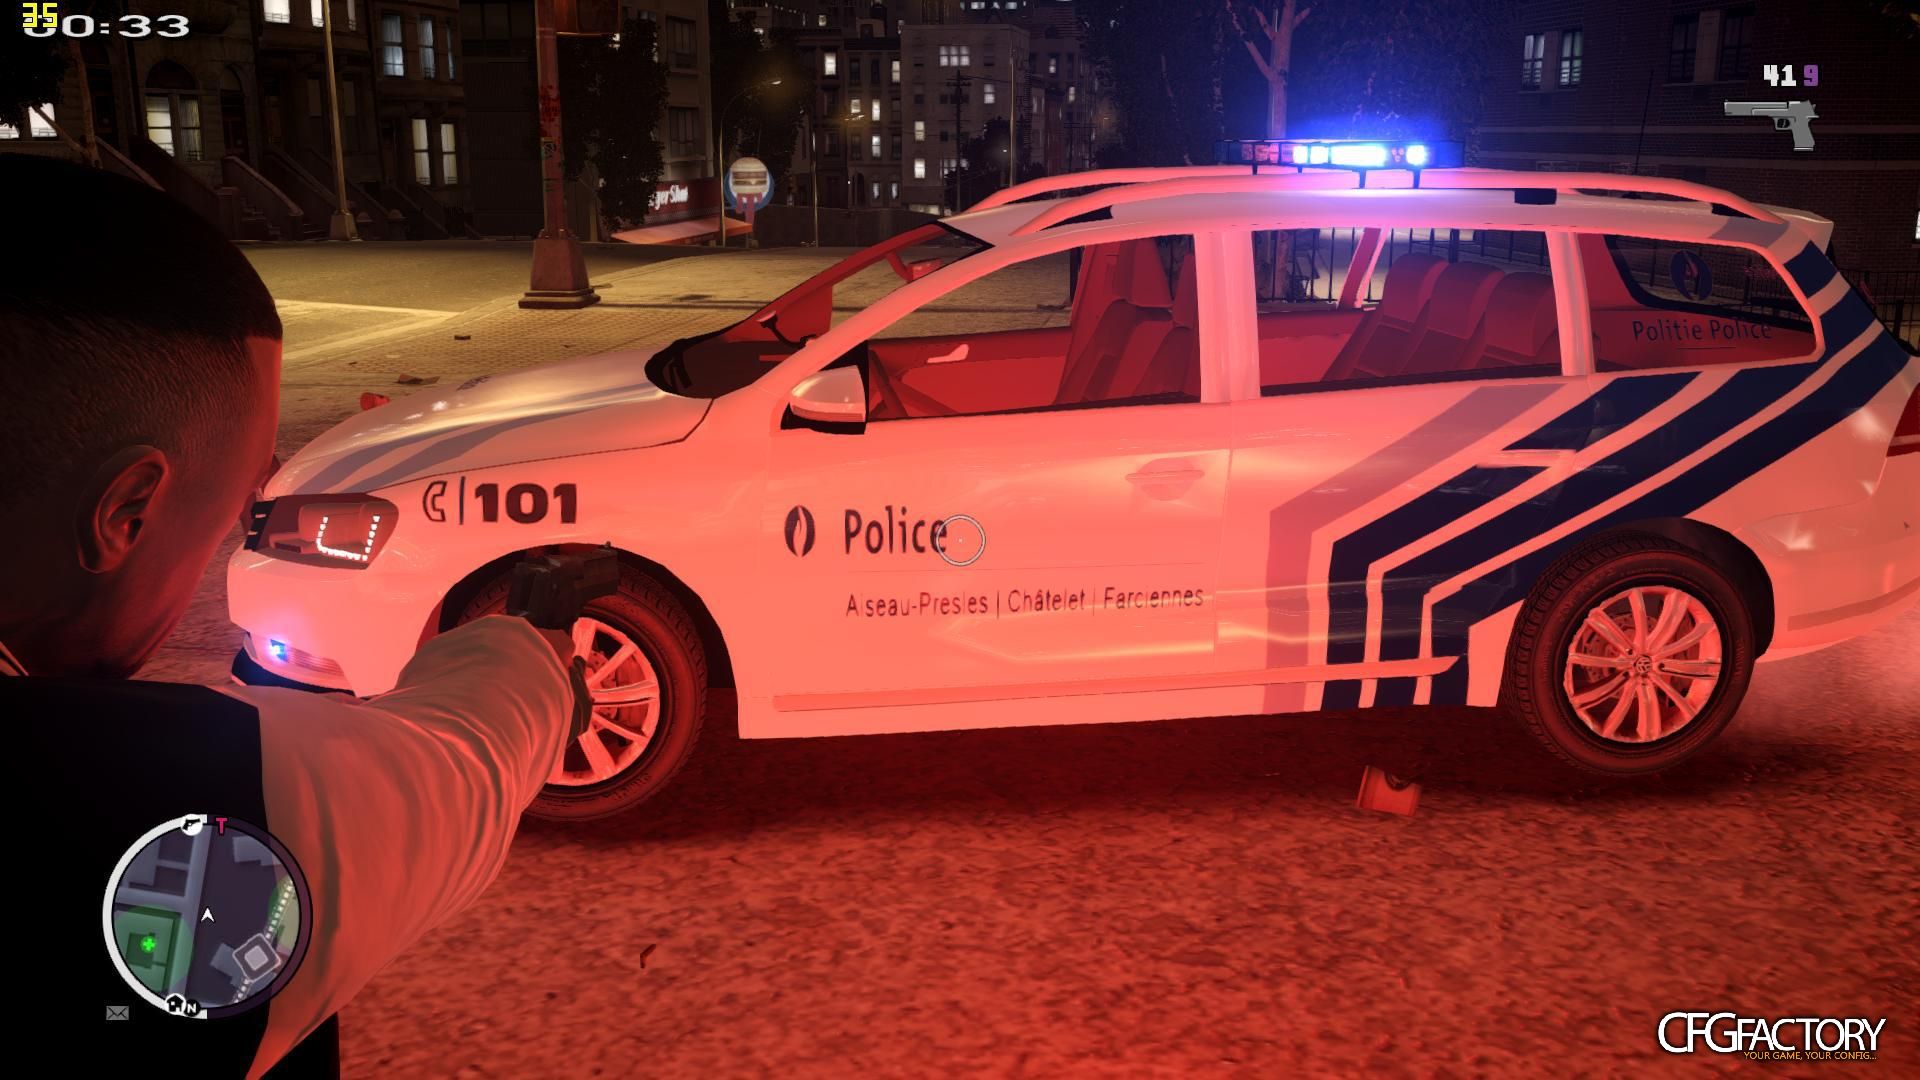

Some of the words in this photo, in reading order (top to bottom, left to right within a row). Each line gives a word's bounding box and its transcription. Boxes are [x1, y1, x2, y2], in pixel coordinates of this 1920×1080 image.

[1632, 319, 1702, 341] Politie
[1709, 319, 1773, 340] Police
[474, 483, 577, 524] 101
[844, 505, 948, 555] Police
[846, 591, 988, 617] Aiseau-Presles
[1007, 587, 1086, 613] Châtelet
[1104, 585, 1204, 612] Farciennes
